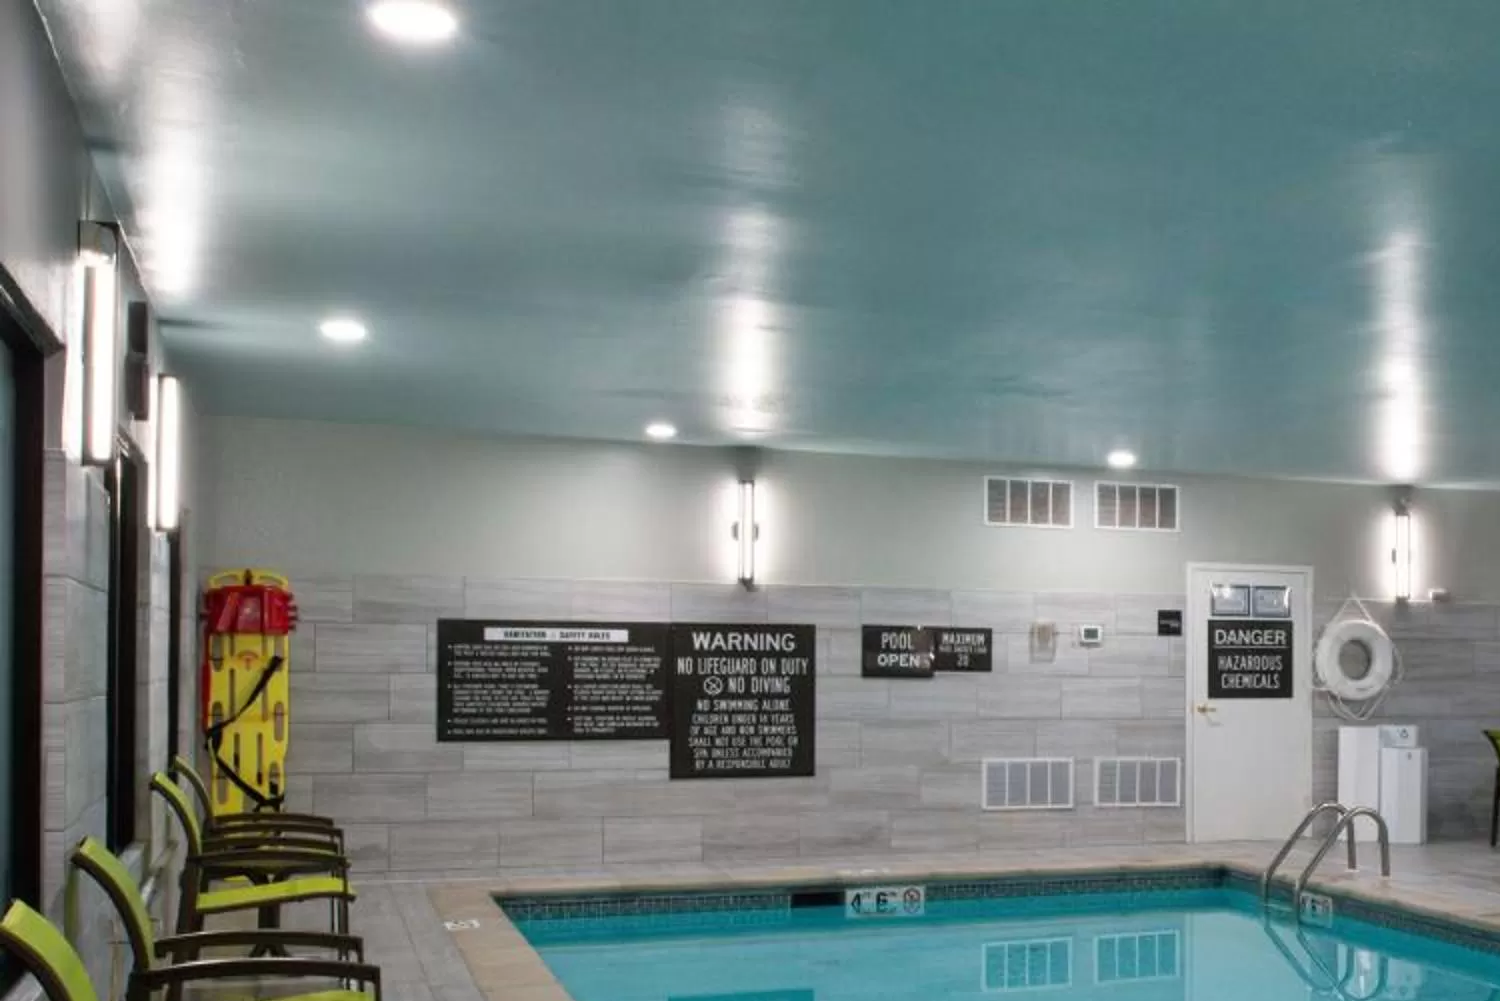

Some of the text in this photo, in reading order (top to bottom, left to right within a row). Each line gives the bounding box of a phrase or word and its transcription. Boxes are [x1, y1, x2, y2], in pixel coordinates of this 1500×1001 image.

[691, 631, 796, 651] WARNING
[881, 632, 914, 650] POOL
[942, 632, 985, 645] MAXIMUM
[1214, 629, 1287, 645] DANGER
[677, 656, 693, 675] NO
[697, 656, 757, 675] LIFEGUARD
[761, 657, 776, 675] ON
[781, 657, 809, 675] DUTY
[877, 653, 920, 668] OPEN
[1217, 655, 1283, 671] HAZARDOUS
[727, 676, 791, 694] NO DIVING
[1221, 673, 1280, 689] CHEMICALS
[696, 699, 790, 711] NO SWIMMING ALONE
